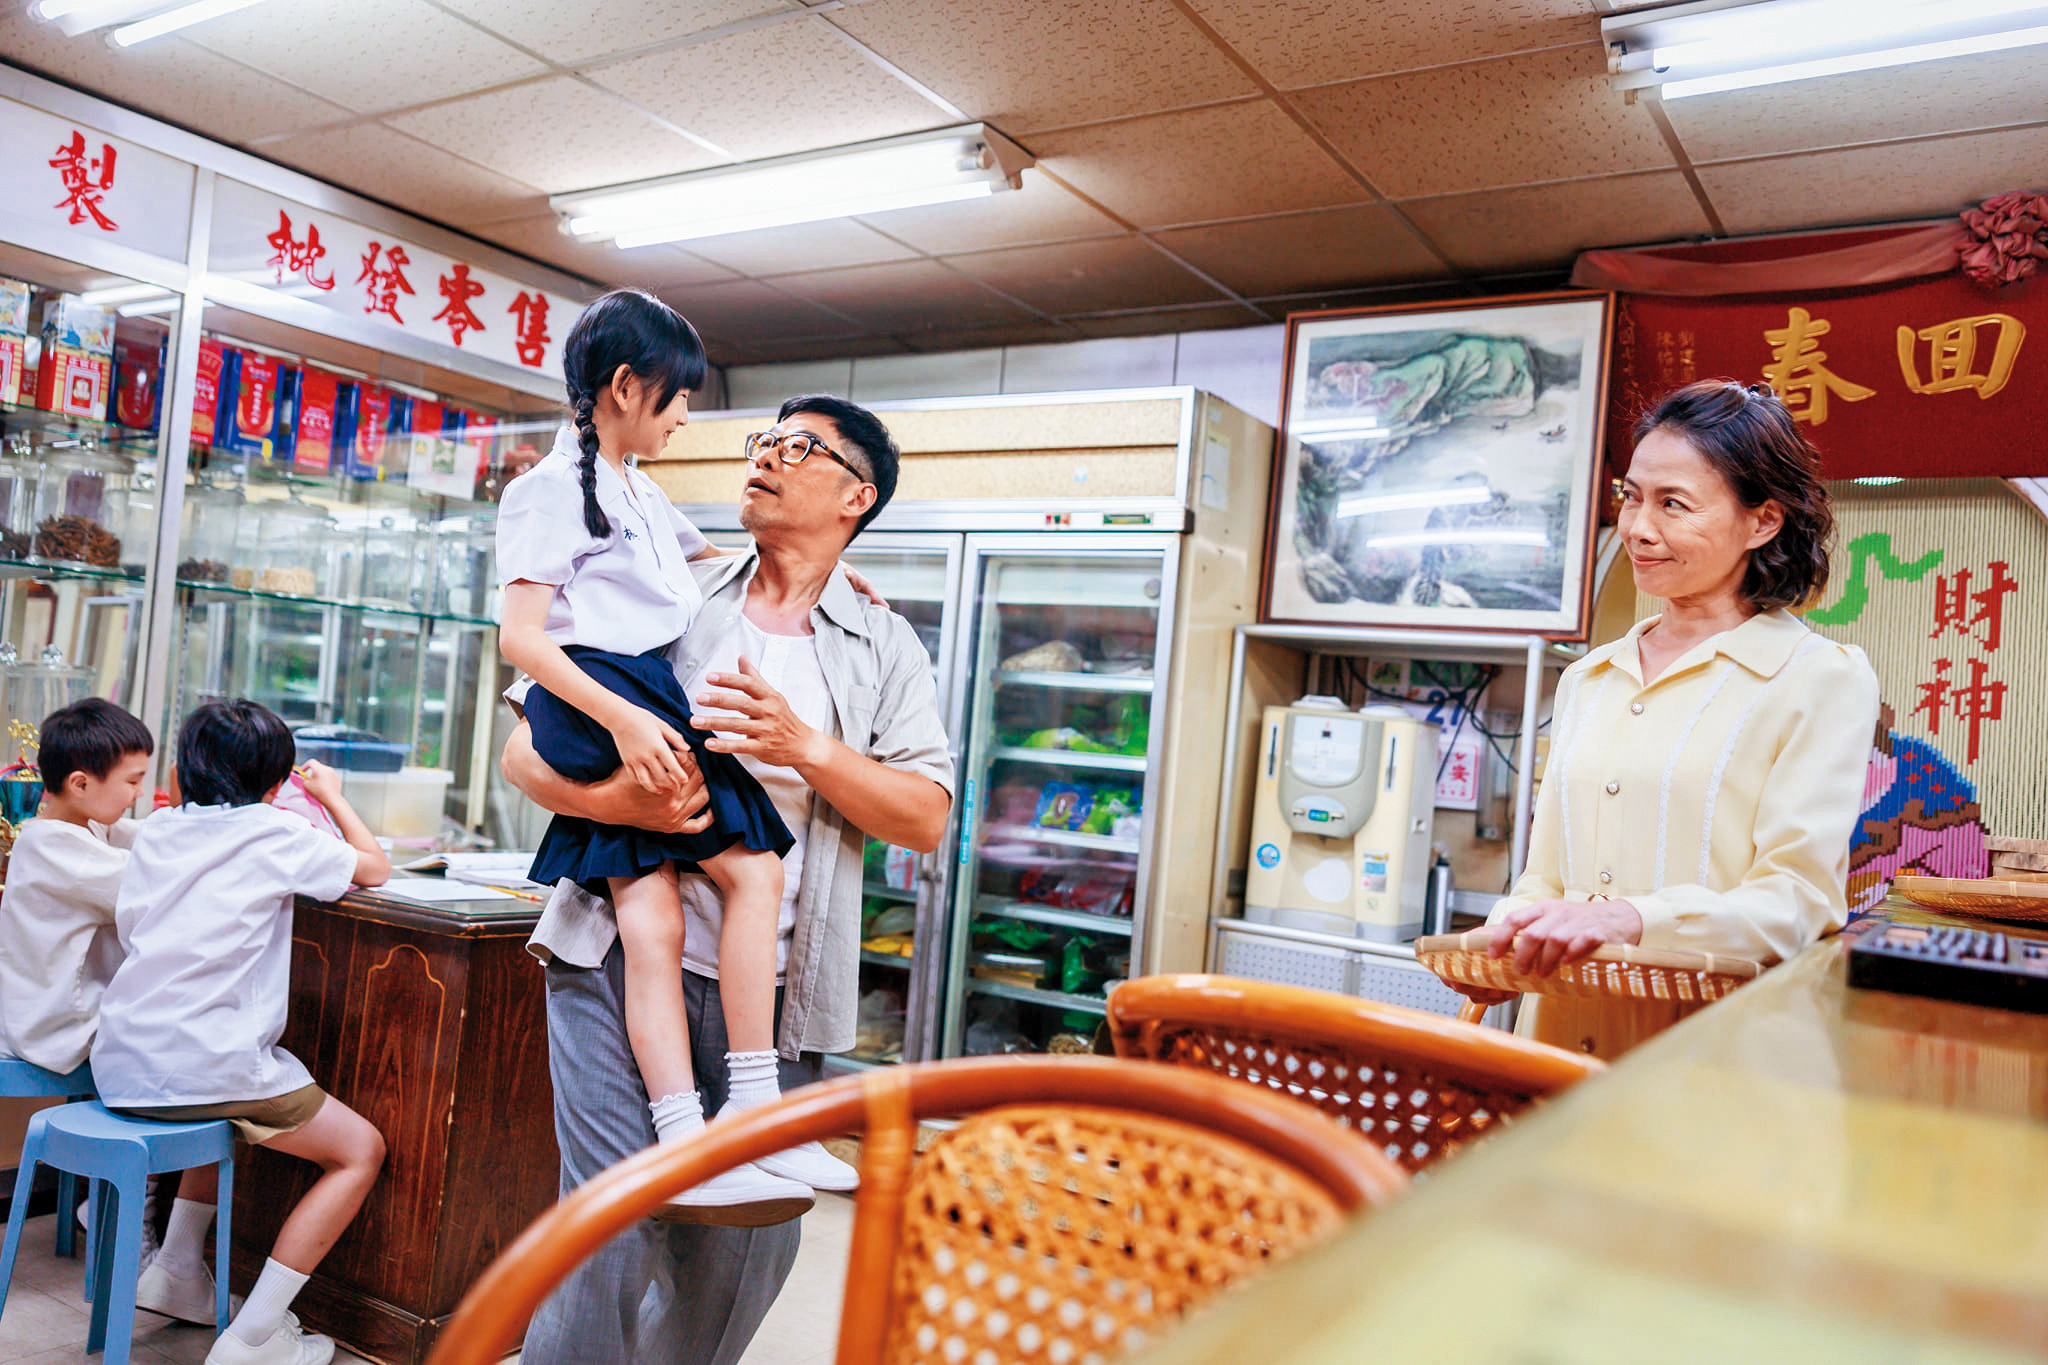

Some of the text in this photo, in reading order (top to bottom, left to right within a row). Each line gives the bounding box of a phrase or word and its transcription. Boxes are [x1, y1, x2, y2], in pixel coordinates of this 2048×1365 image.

[48, 130, 552, 368] 製 批發零售
[1909, 561, 2018, 765] 財神
